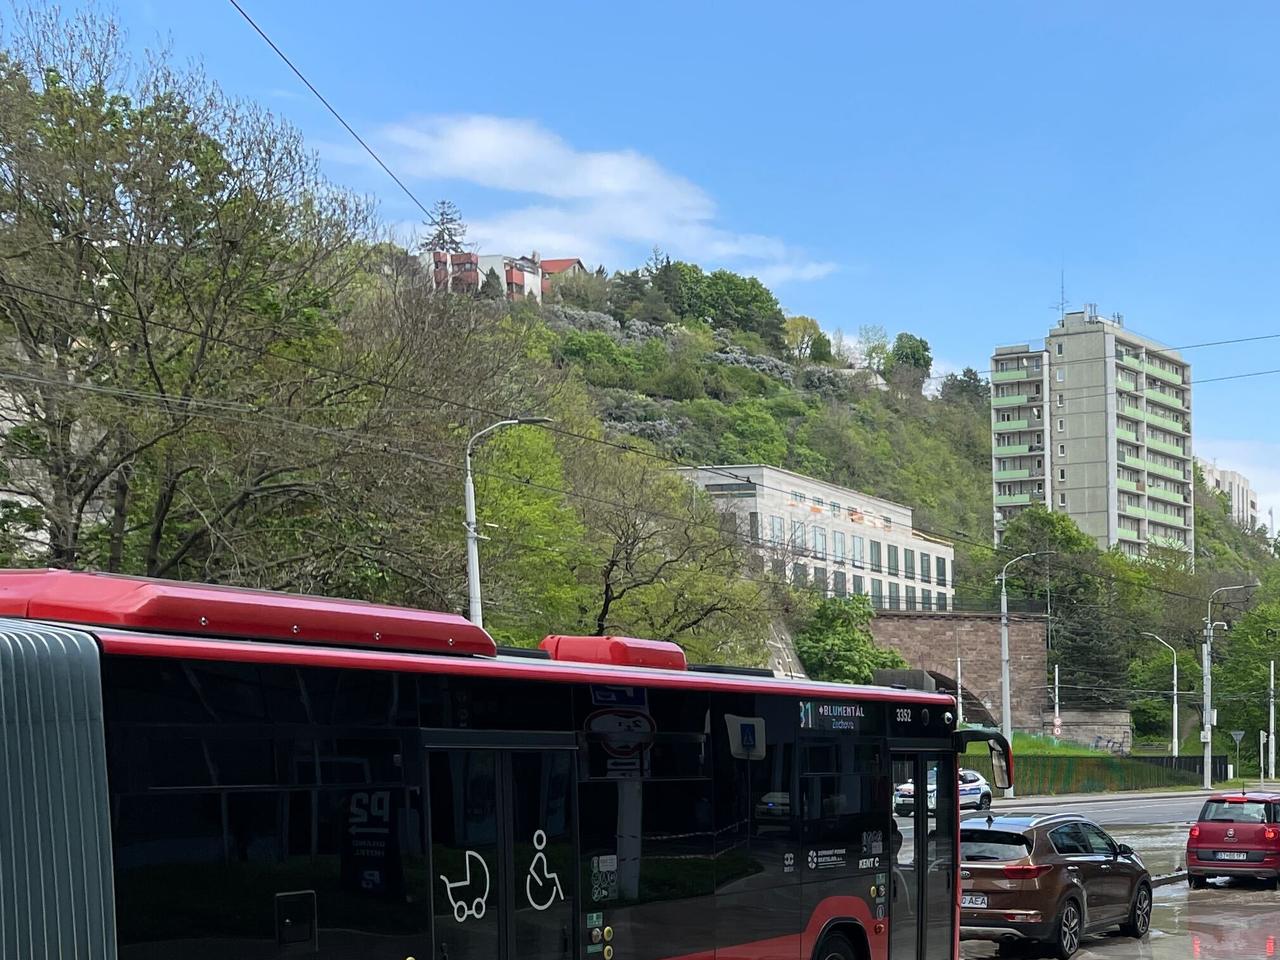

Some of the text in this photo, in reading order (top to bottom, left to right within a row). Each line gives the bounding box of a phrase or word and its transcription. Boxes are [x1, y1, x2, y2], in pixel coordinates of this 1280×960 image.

[896, 709, 912, 722] 3352
[859, 857, 880, 869] KENT C
[968, 896, 987, 905] AEA
